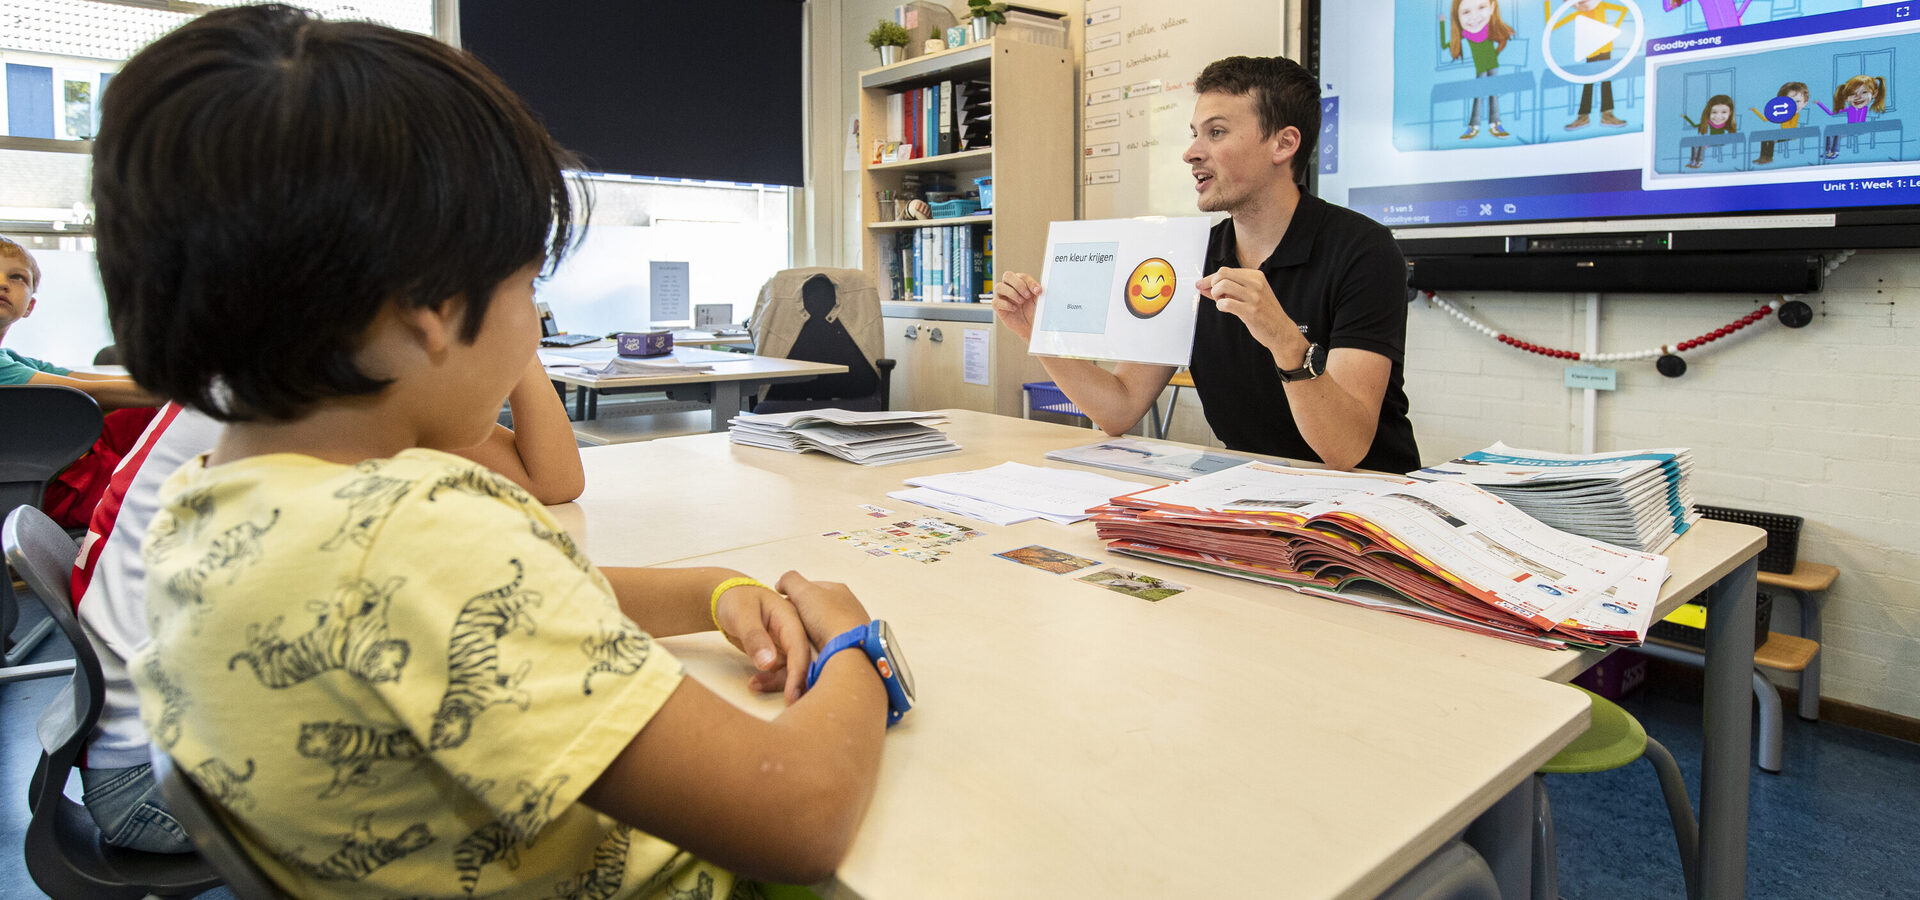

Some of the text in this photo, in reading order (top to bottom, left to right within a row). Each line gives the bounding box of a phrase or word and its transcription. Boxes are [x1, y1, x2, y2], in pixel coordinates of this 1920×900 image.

[1653, 36, 1722, 51] Goodbye-song
[1823, 183, 1846, 191] Unit
[1849, 182, 1859, 190] 1:
[1861, 180, 1893, 189] Week
[1896, 179, 1907, 188] 1:
[1069, 253, 1088, 262] kleur
[1088, 252, 1114, 263] krijgen
